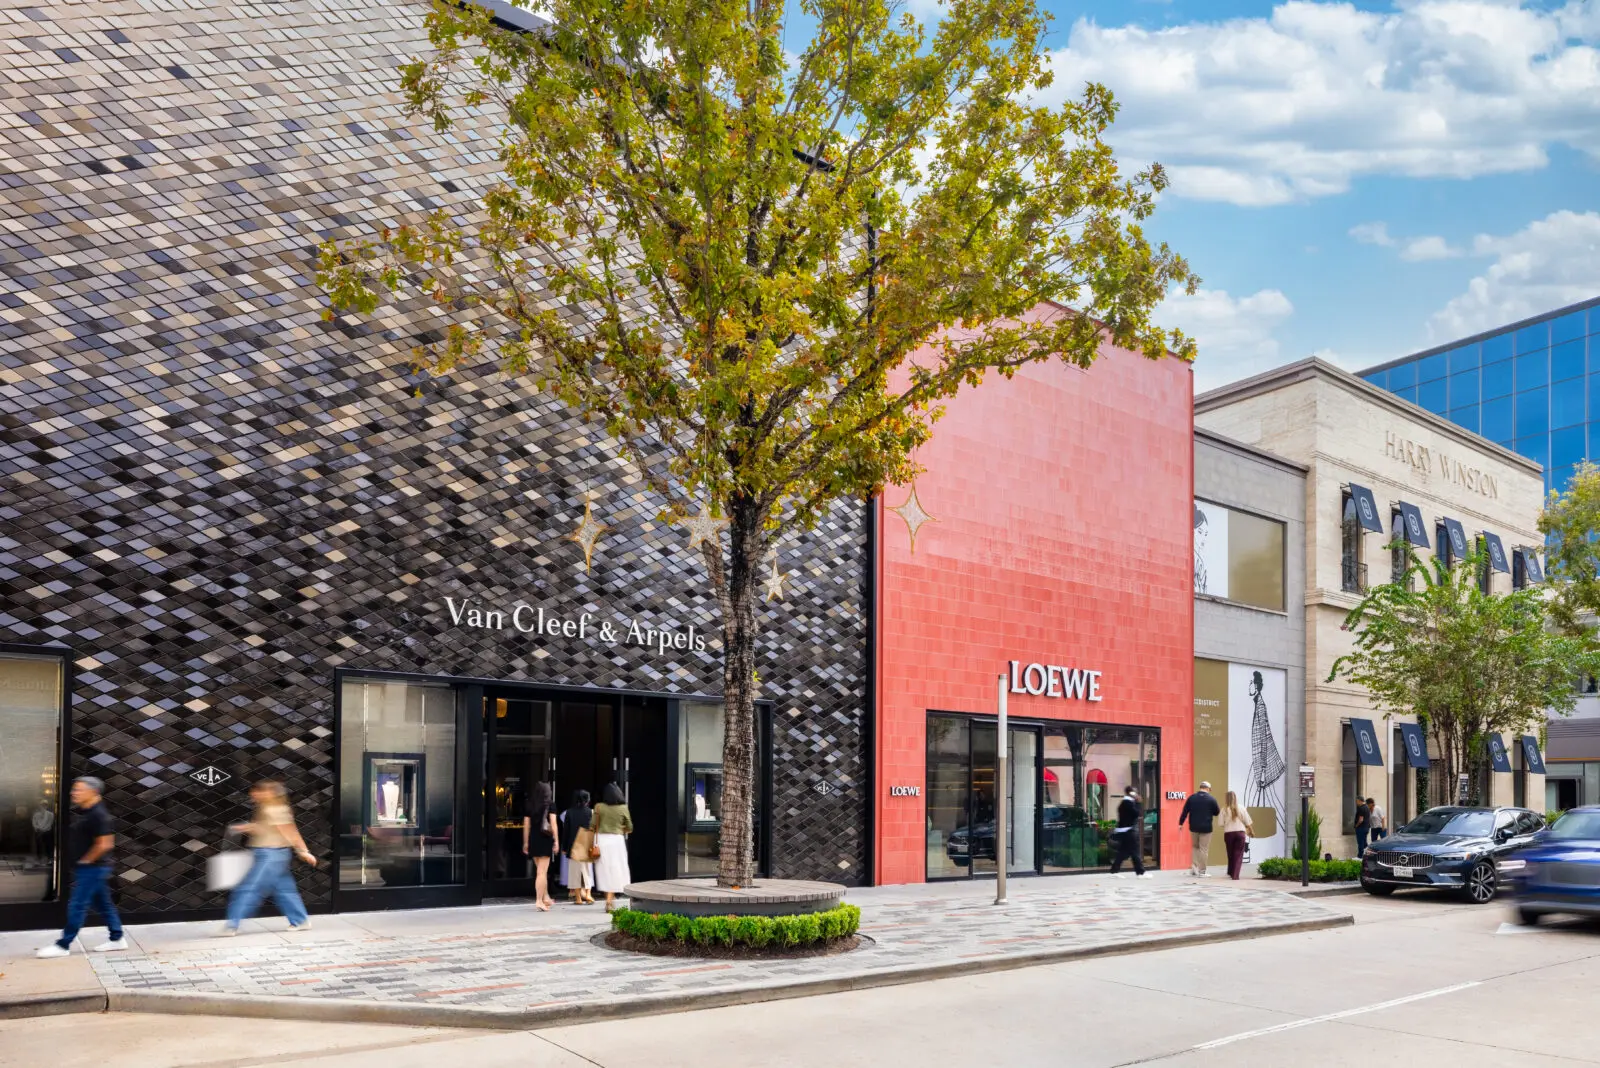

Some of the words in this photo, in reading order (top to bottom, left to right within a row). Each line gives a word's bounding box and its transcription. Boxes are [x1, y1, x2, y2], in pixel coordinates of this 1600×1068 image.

[1385, 430, 1431, 474] HARRY
[1439, 452, 1498, 500] WINSTON
[443, 596, 502, 630] Van
[513, 604, 592, 640] Cleef
[599, 621, 618, 642] &
[626, 618, 705, 655] Arpels
[1008, 660, 1103, 702] LOEWE
[890, 785, 921, 797] LOEWE
[1166, 791, 1187, 800] LOEWE
